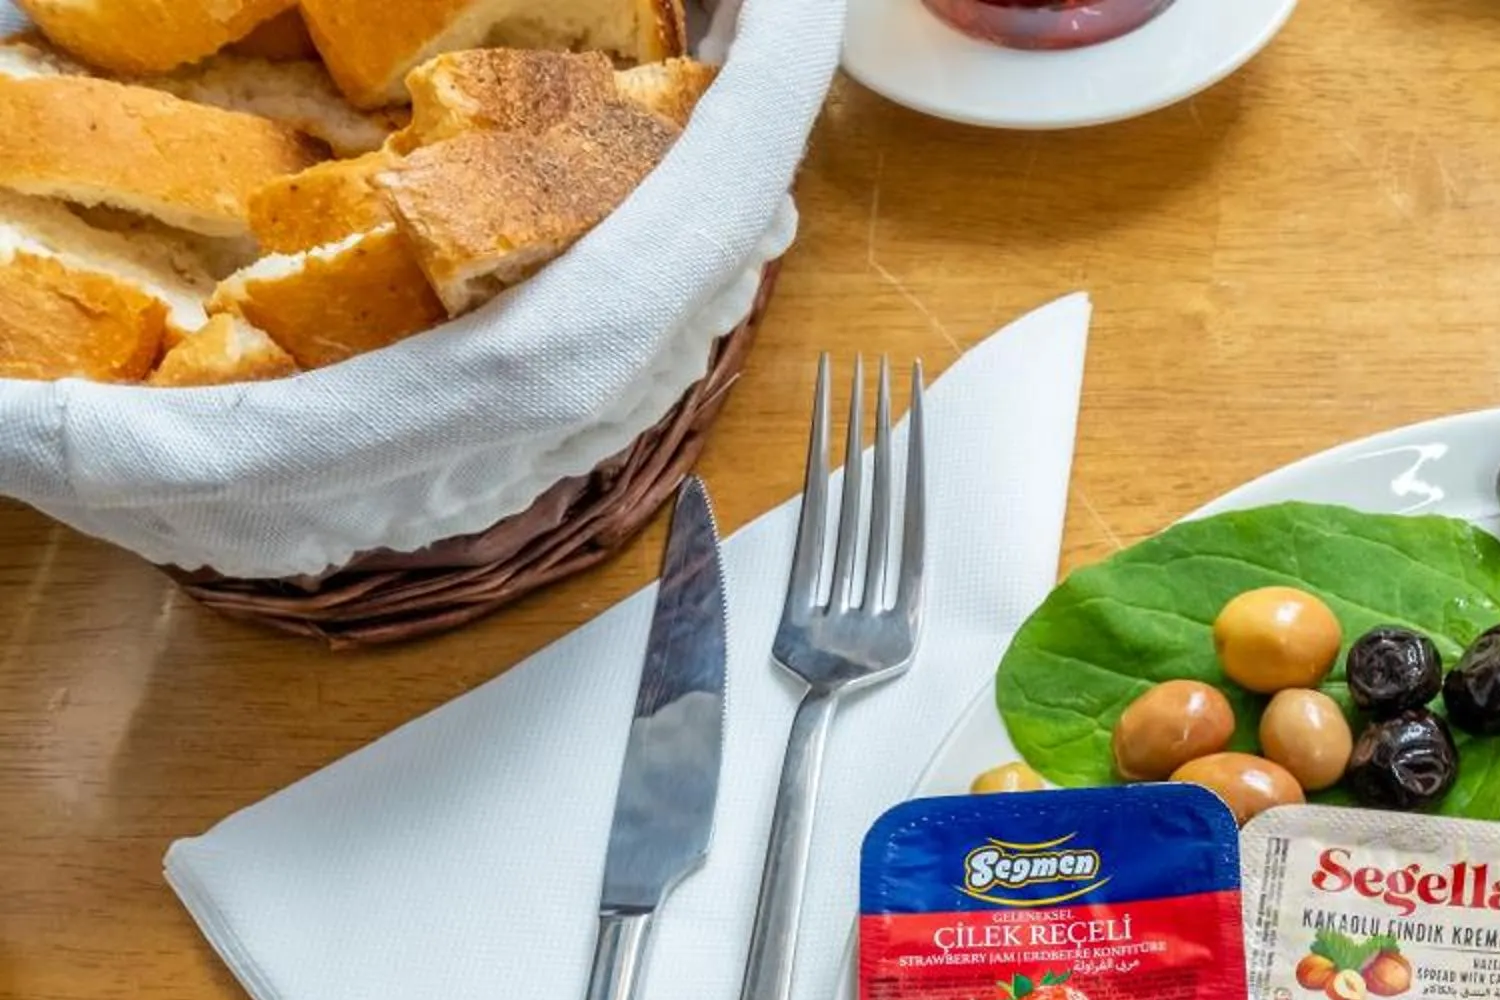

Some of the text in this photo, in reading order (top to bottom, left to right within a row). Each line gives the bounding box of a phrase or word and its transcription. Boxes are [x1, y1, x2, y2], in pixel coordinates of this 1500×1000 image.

[933, 914, 1133, 956] ÇİLEK REÇELİ
[899, 953, 988, 967] STRAWBERRY
[989, 952, 1016, 966] JAM
